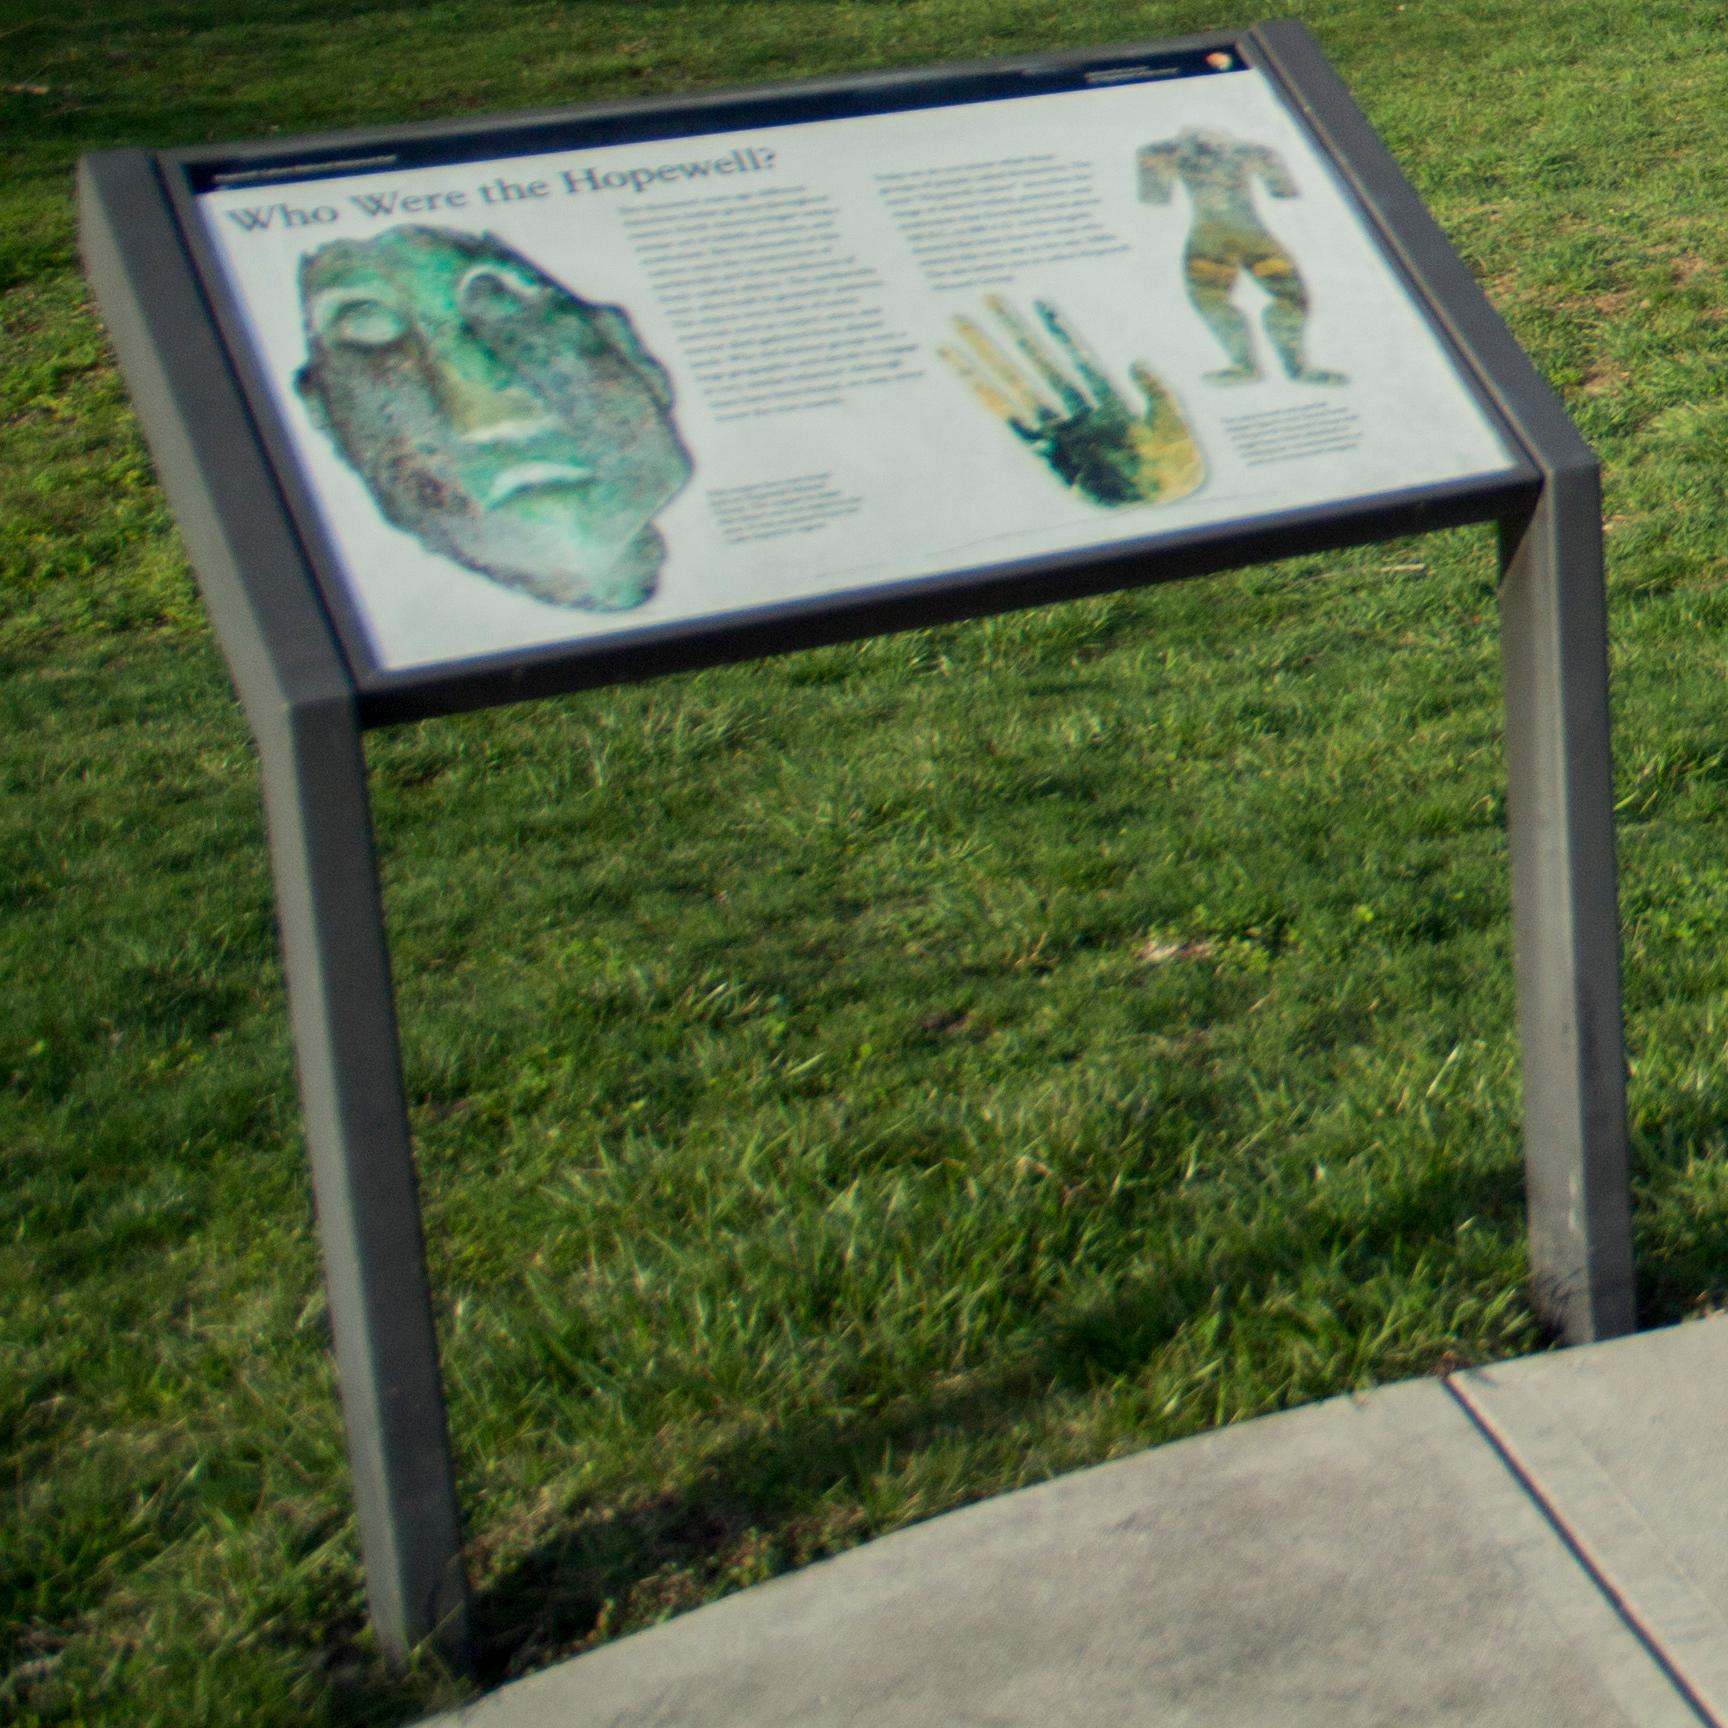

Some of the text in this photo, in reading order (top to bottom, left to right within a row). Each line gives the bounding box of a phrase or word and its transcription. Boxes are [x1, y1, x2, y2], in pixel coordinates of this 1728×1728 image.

[225, 146, 776, 232] Who Were the Hopewell?
